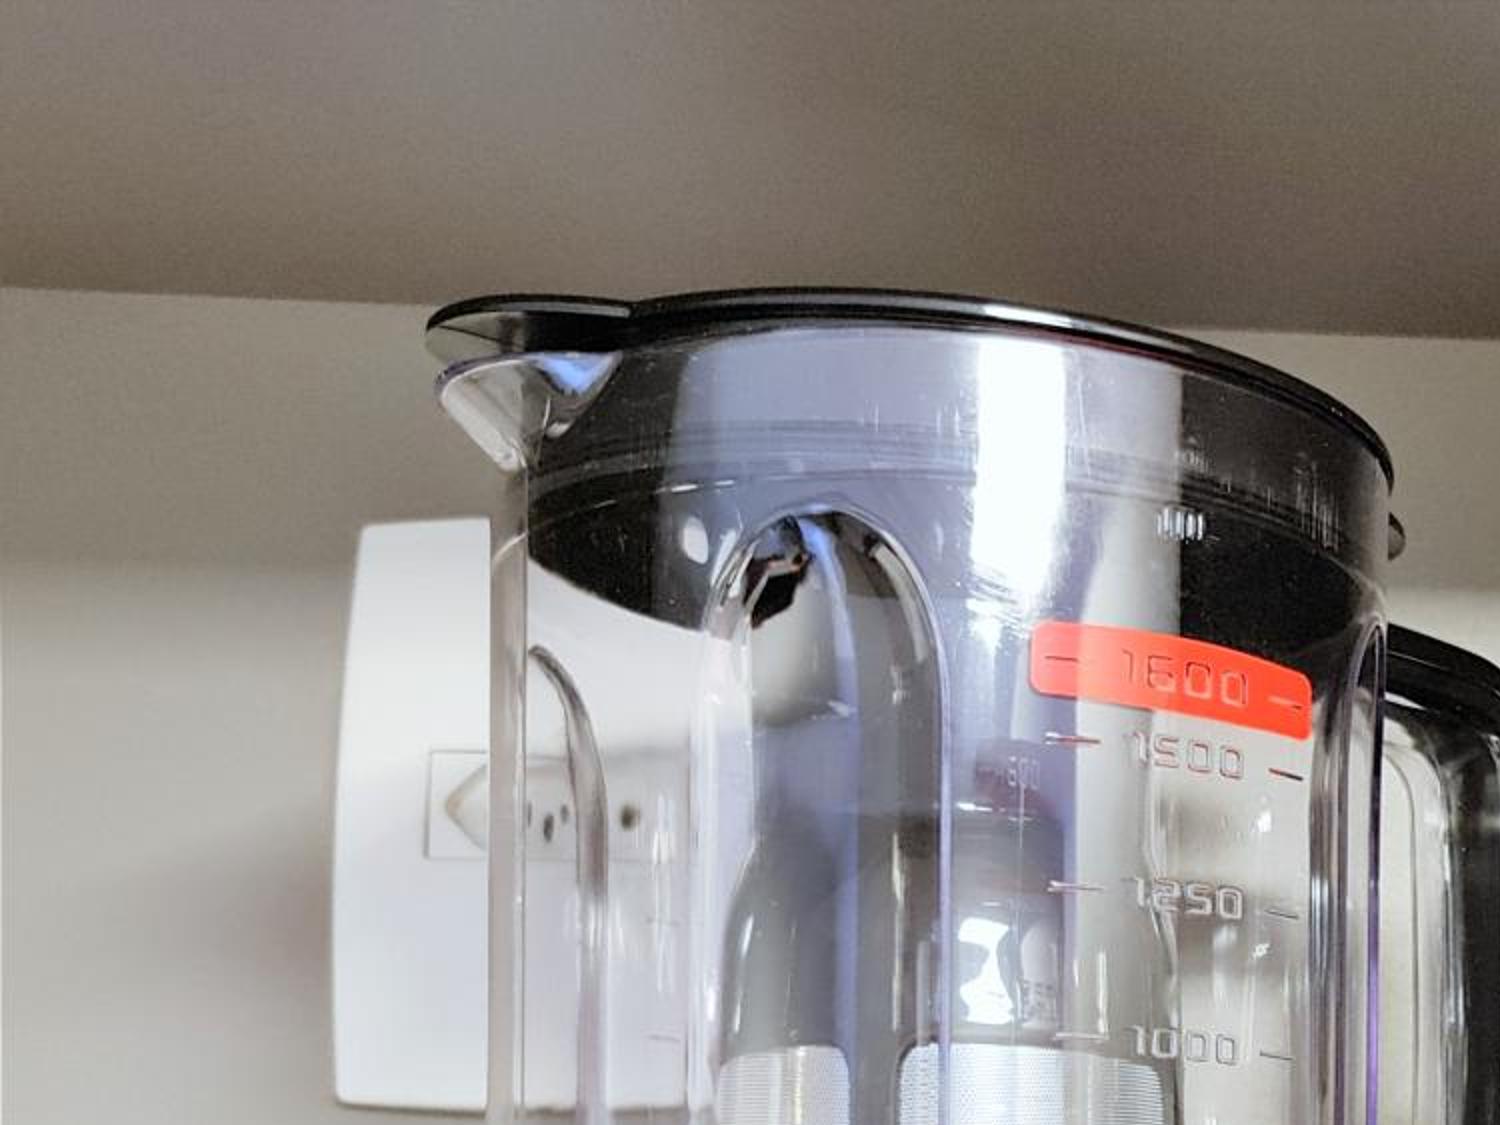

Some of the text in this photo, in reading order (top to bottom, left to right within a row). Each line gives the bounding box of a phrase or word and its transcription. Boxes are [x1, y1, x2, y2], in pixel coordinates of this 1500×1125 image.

[1121, 649, 1249, 708] 1600
[1126, 731, 1245, 780] 1500
[1121, 873, 1243, 921] 1250
[1122, 1024, 1237, 1066] 1000
